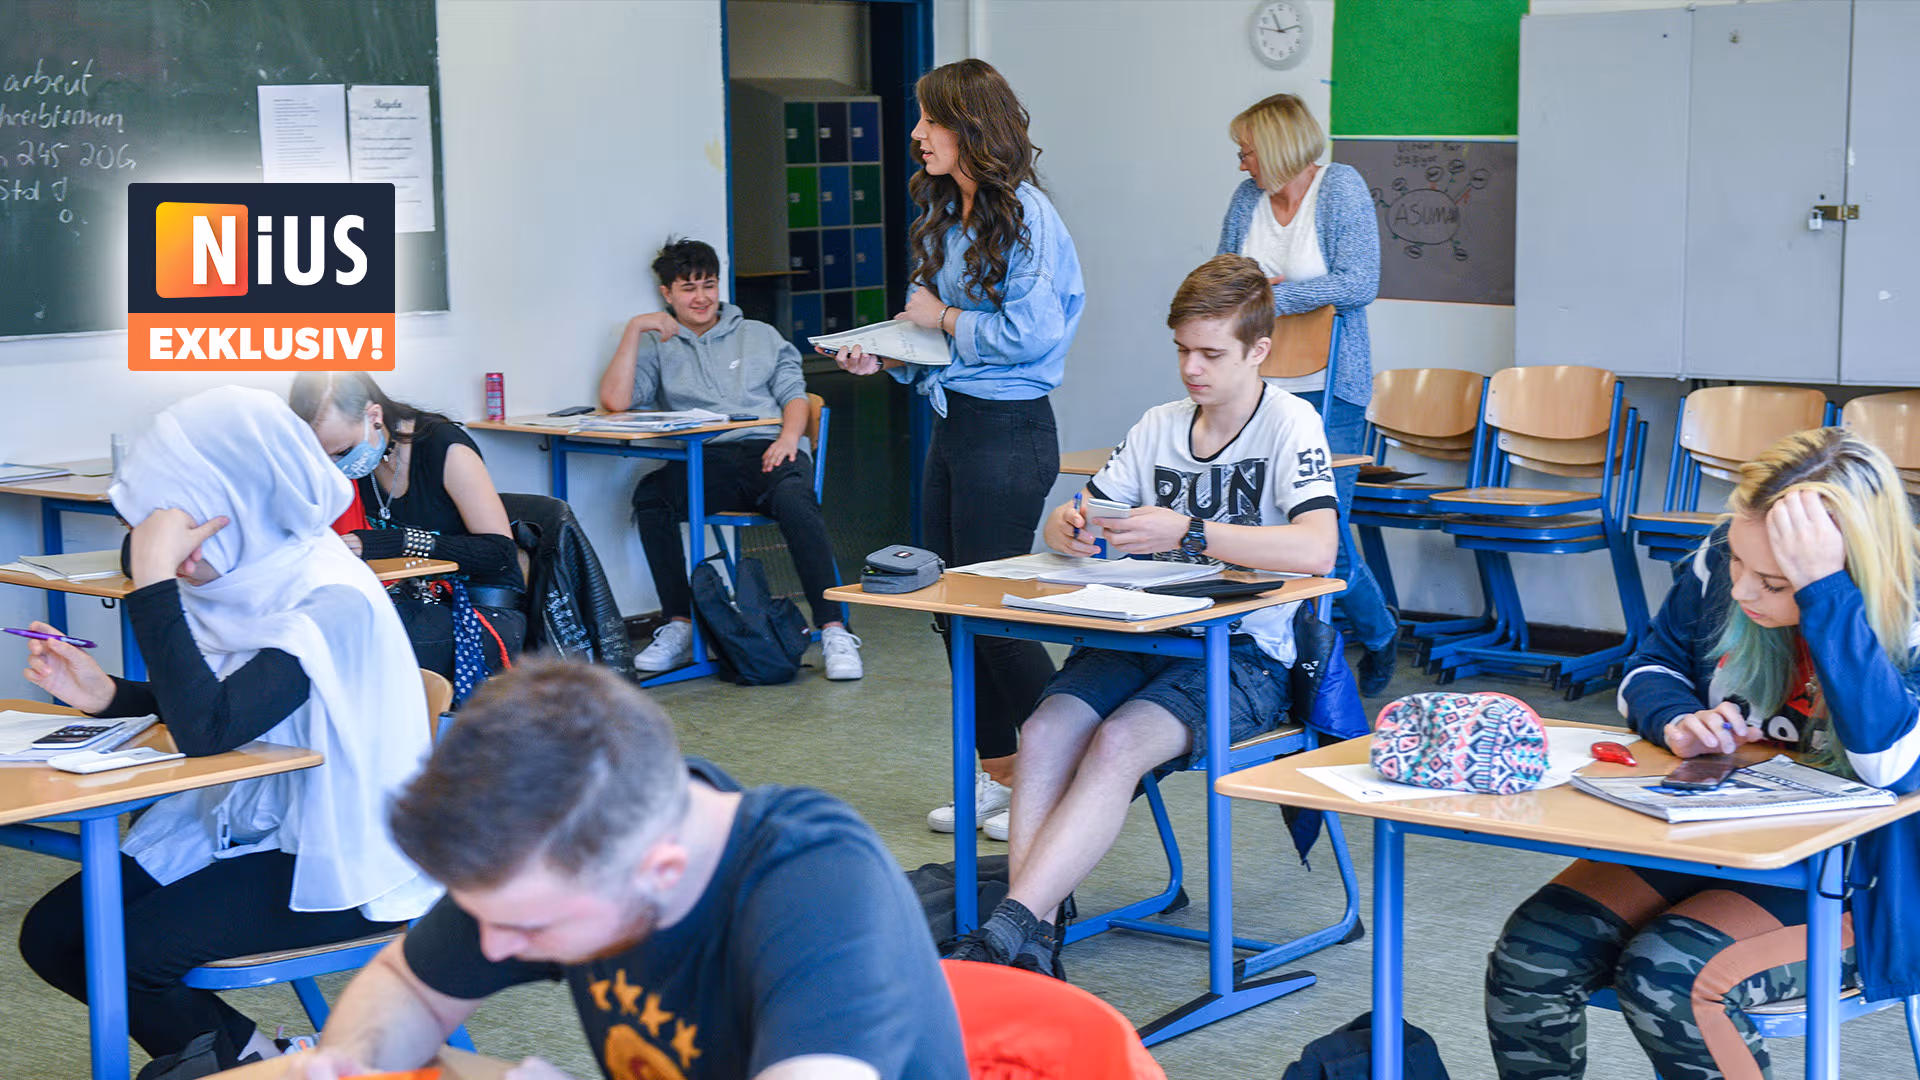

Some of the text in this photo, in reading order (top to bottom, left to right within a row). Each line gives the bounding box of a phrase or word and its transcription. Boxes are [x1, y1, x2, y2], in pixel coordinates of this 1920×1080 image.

[16, 140, 69, 168] 245
[1296, 447, 1329, 478] 52
[1154, 460, 1266, 520] RUN
